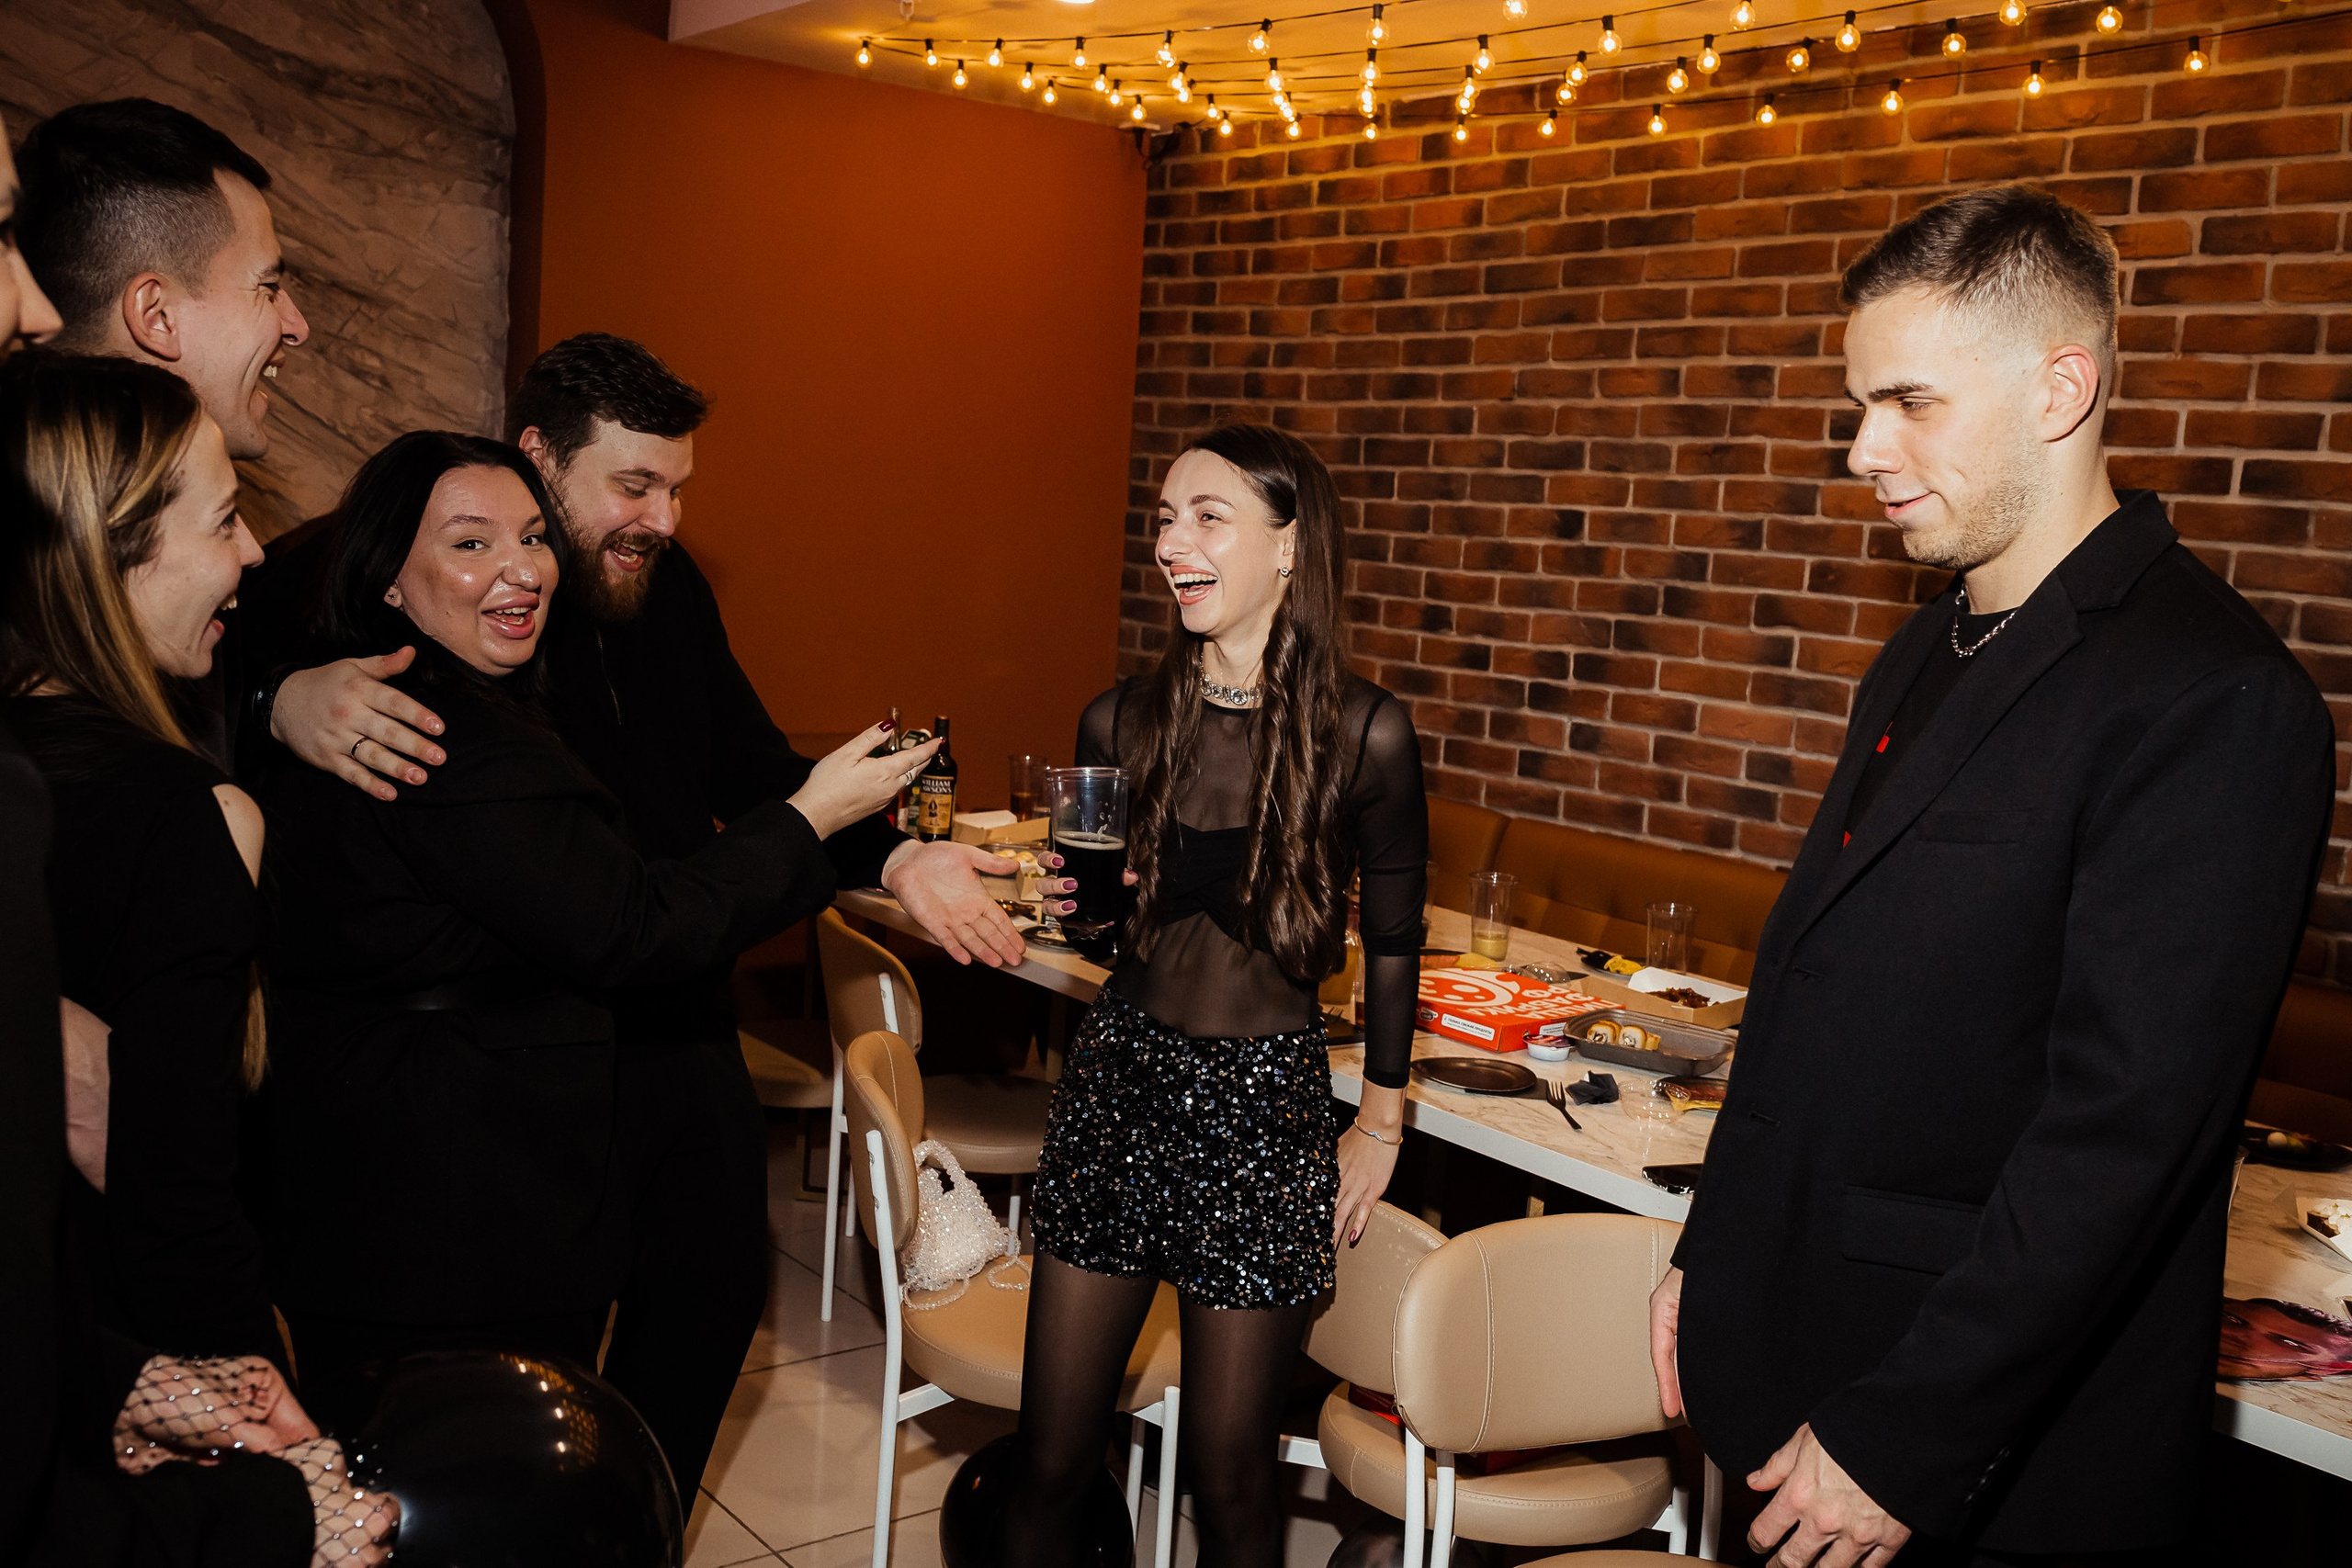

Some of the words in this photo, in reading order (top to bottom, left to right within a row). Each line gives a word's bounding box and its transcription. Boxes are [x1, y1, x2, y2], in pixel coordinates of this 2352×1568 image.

[922, 779, 951, 787] WILLIAM
[1521, 985, 1572, 998] РФ
[1456, 992, 1595, 1017] ФАБРИКА
